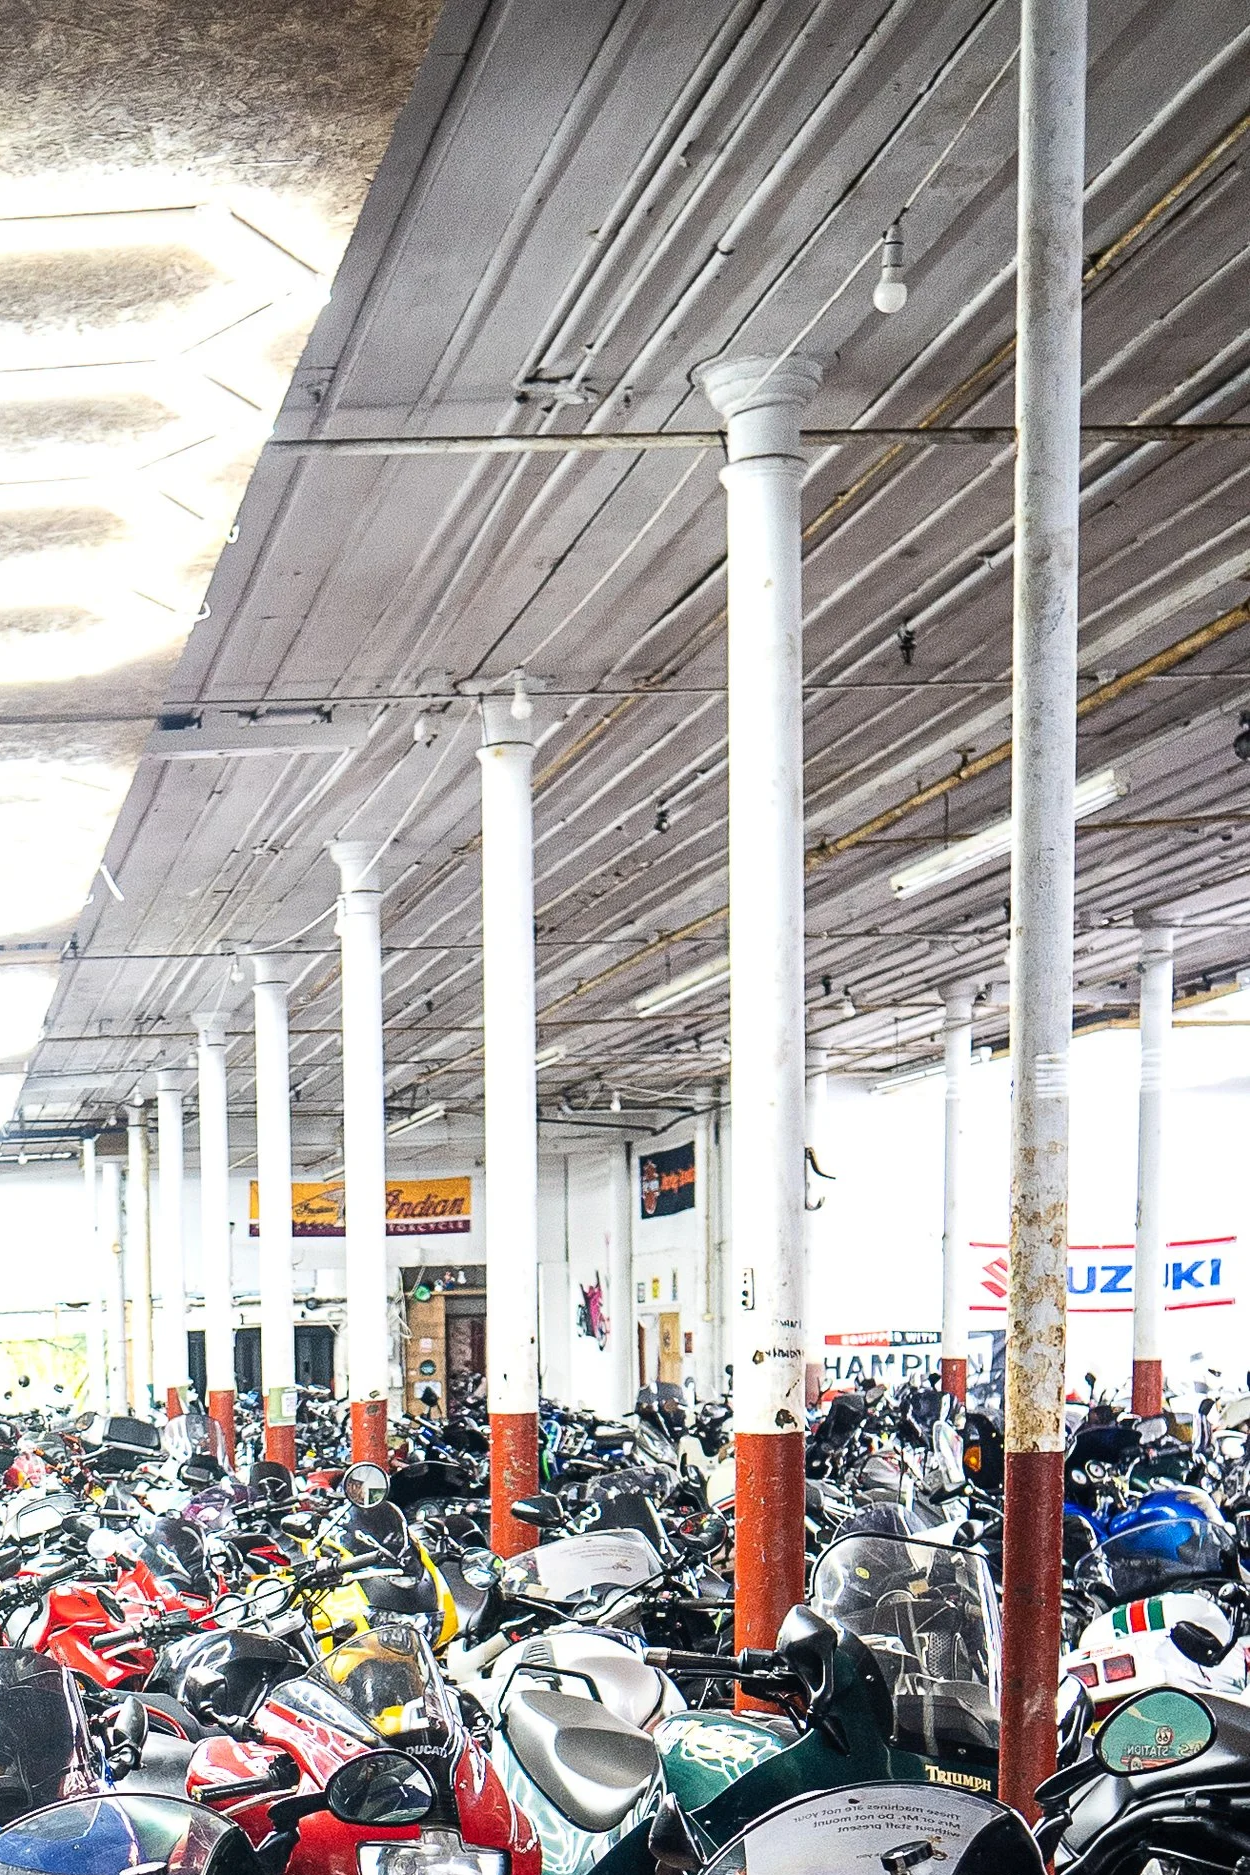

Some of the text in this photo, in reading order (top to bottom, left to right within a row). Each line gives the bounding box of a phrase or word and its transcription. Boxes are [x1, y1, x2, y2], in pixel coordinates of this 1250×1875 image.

[386, 1188, 465, 1217] Indian
[387, 1221, 464, 1233] TORCYCLE
[1067, 1258, 1221, 1294] UZKI
[905, 1331, 938, 1344] WITH
[824, 1353, 984, 1380] HAMPIN
[924, 1764, 992, 1792] TRIUMPH
